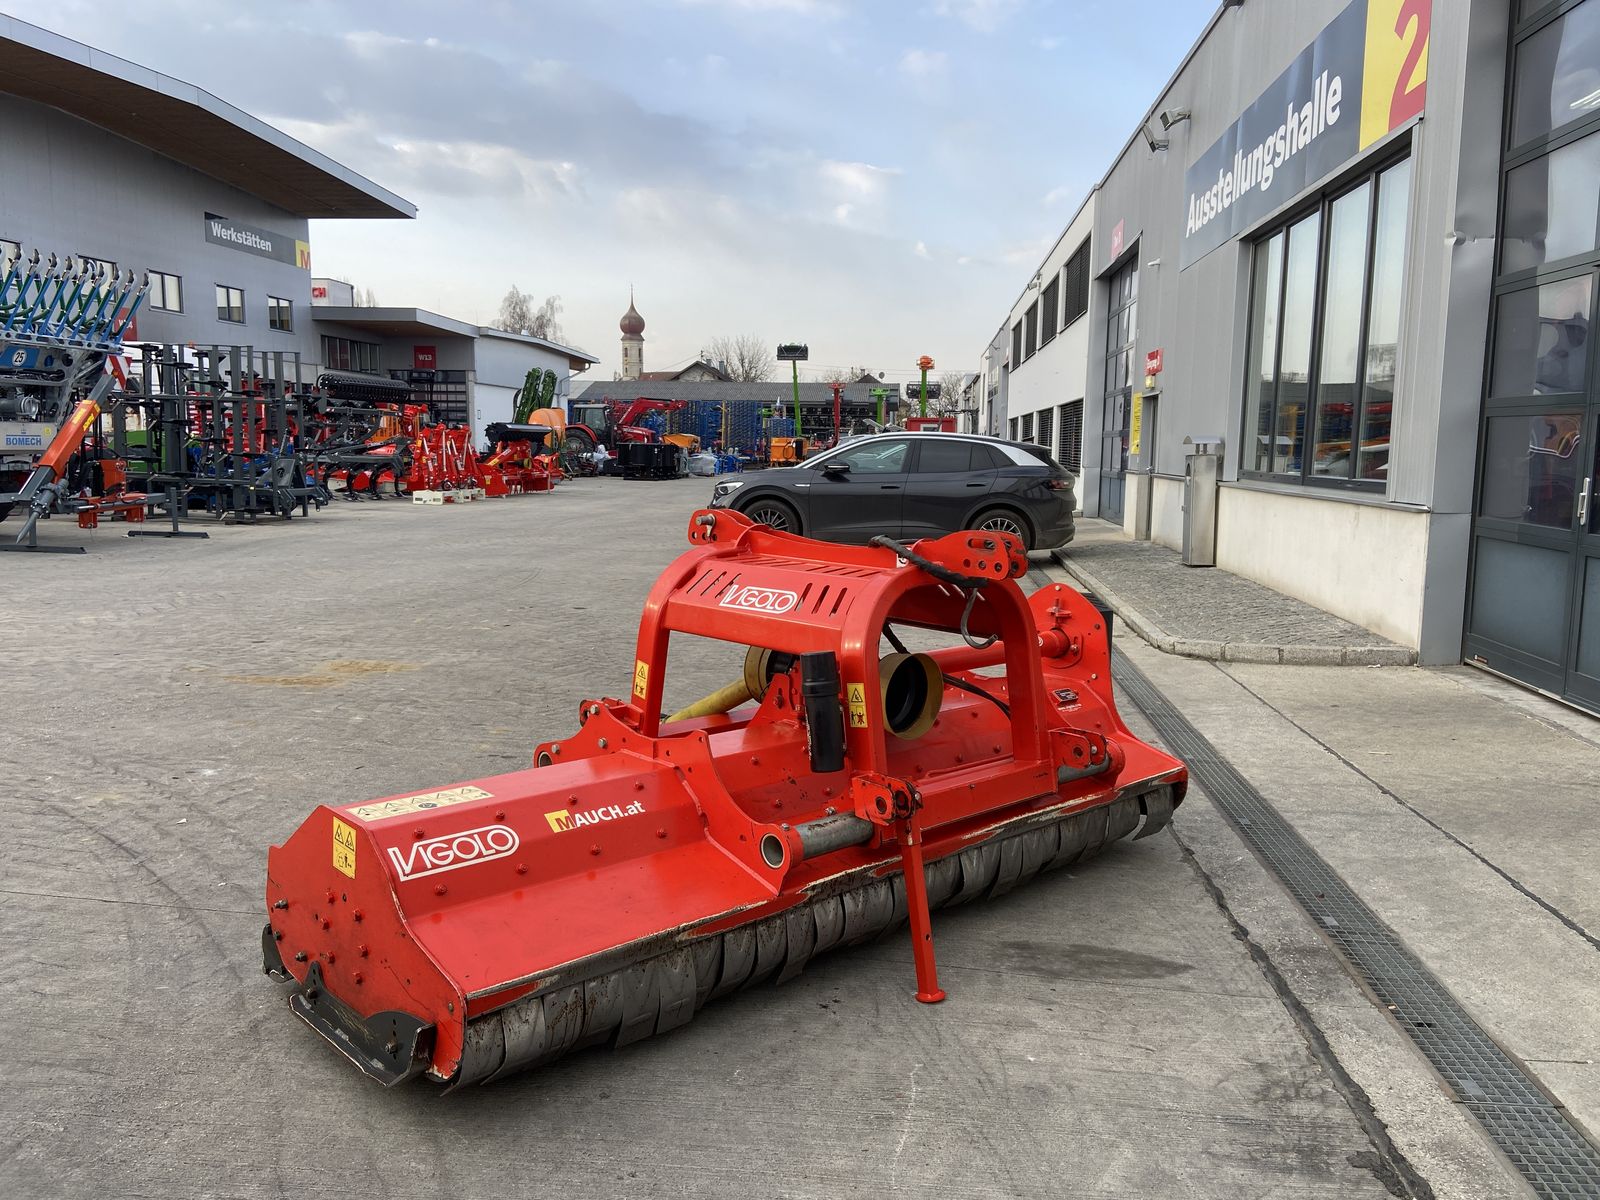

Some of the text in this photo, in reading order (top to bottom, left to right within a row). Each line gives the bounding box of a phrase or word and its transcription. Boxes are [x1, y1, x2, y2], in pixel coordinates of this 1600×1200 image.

[1186, 0, 1432, 238] Ausstellungshalle 2
[211, 221, 272, 252] Werkstätten
[14, 351, 25, 363] 25
[6, 436, 42, 446] BOMECH
[721, 586, 796, 613] VIGOLO
[555, 800, 646, 831] MAUCH.at
[390, 826, 518, 879] VIGOLO
